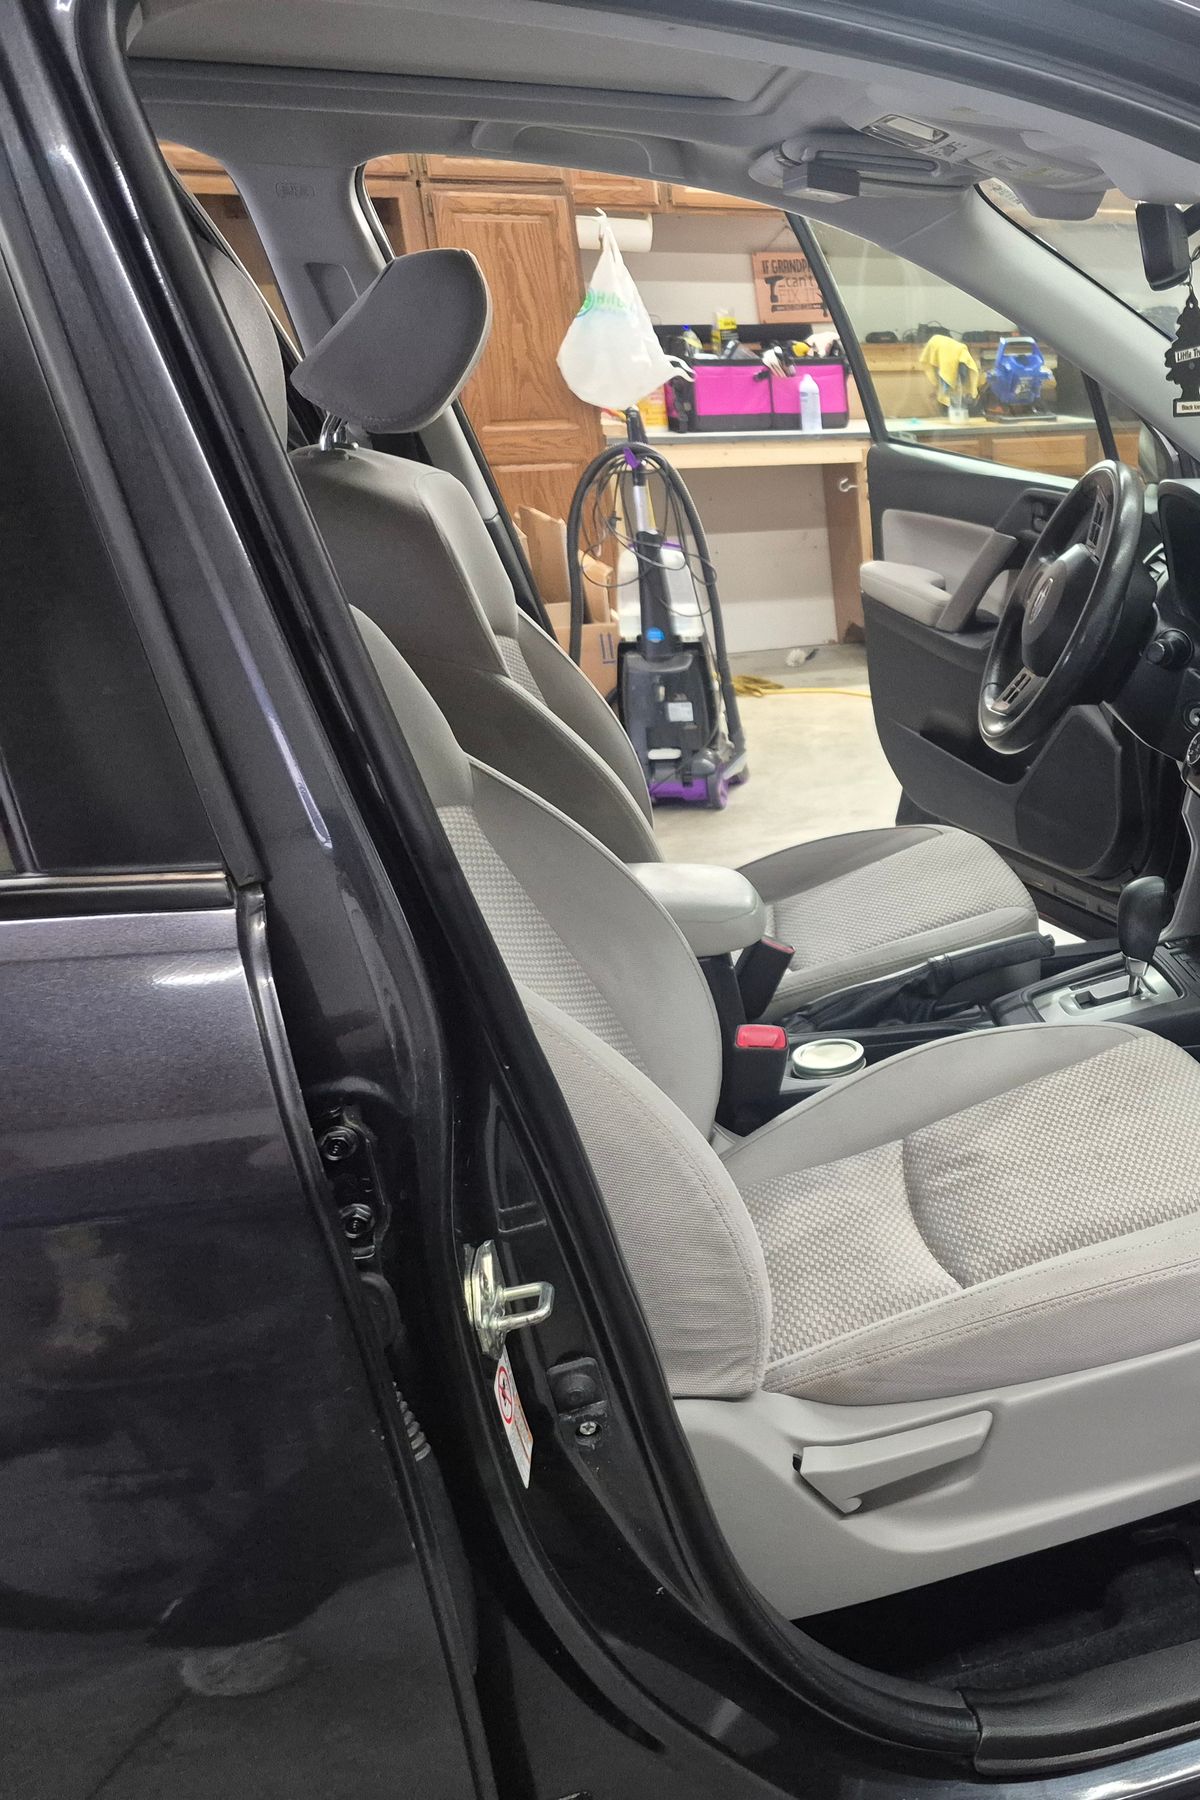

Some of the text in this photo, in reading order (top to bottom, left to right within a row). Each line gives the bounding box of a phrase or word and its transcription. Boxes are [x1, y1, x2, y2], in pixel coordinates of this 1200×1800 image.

[761, 258, 811, 274] IF GRANDP
[1177, 351, 1192, 362] Little
